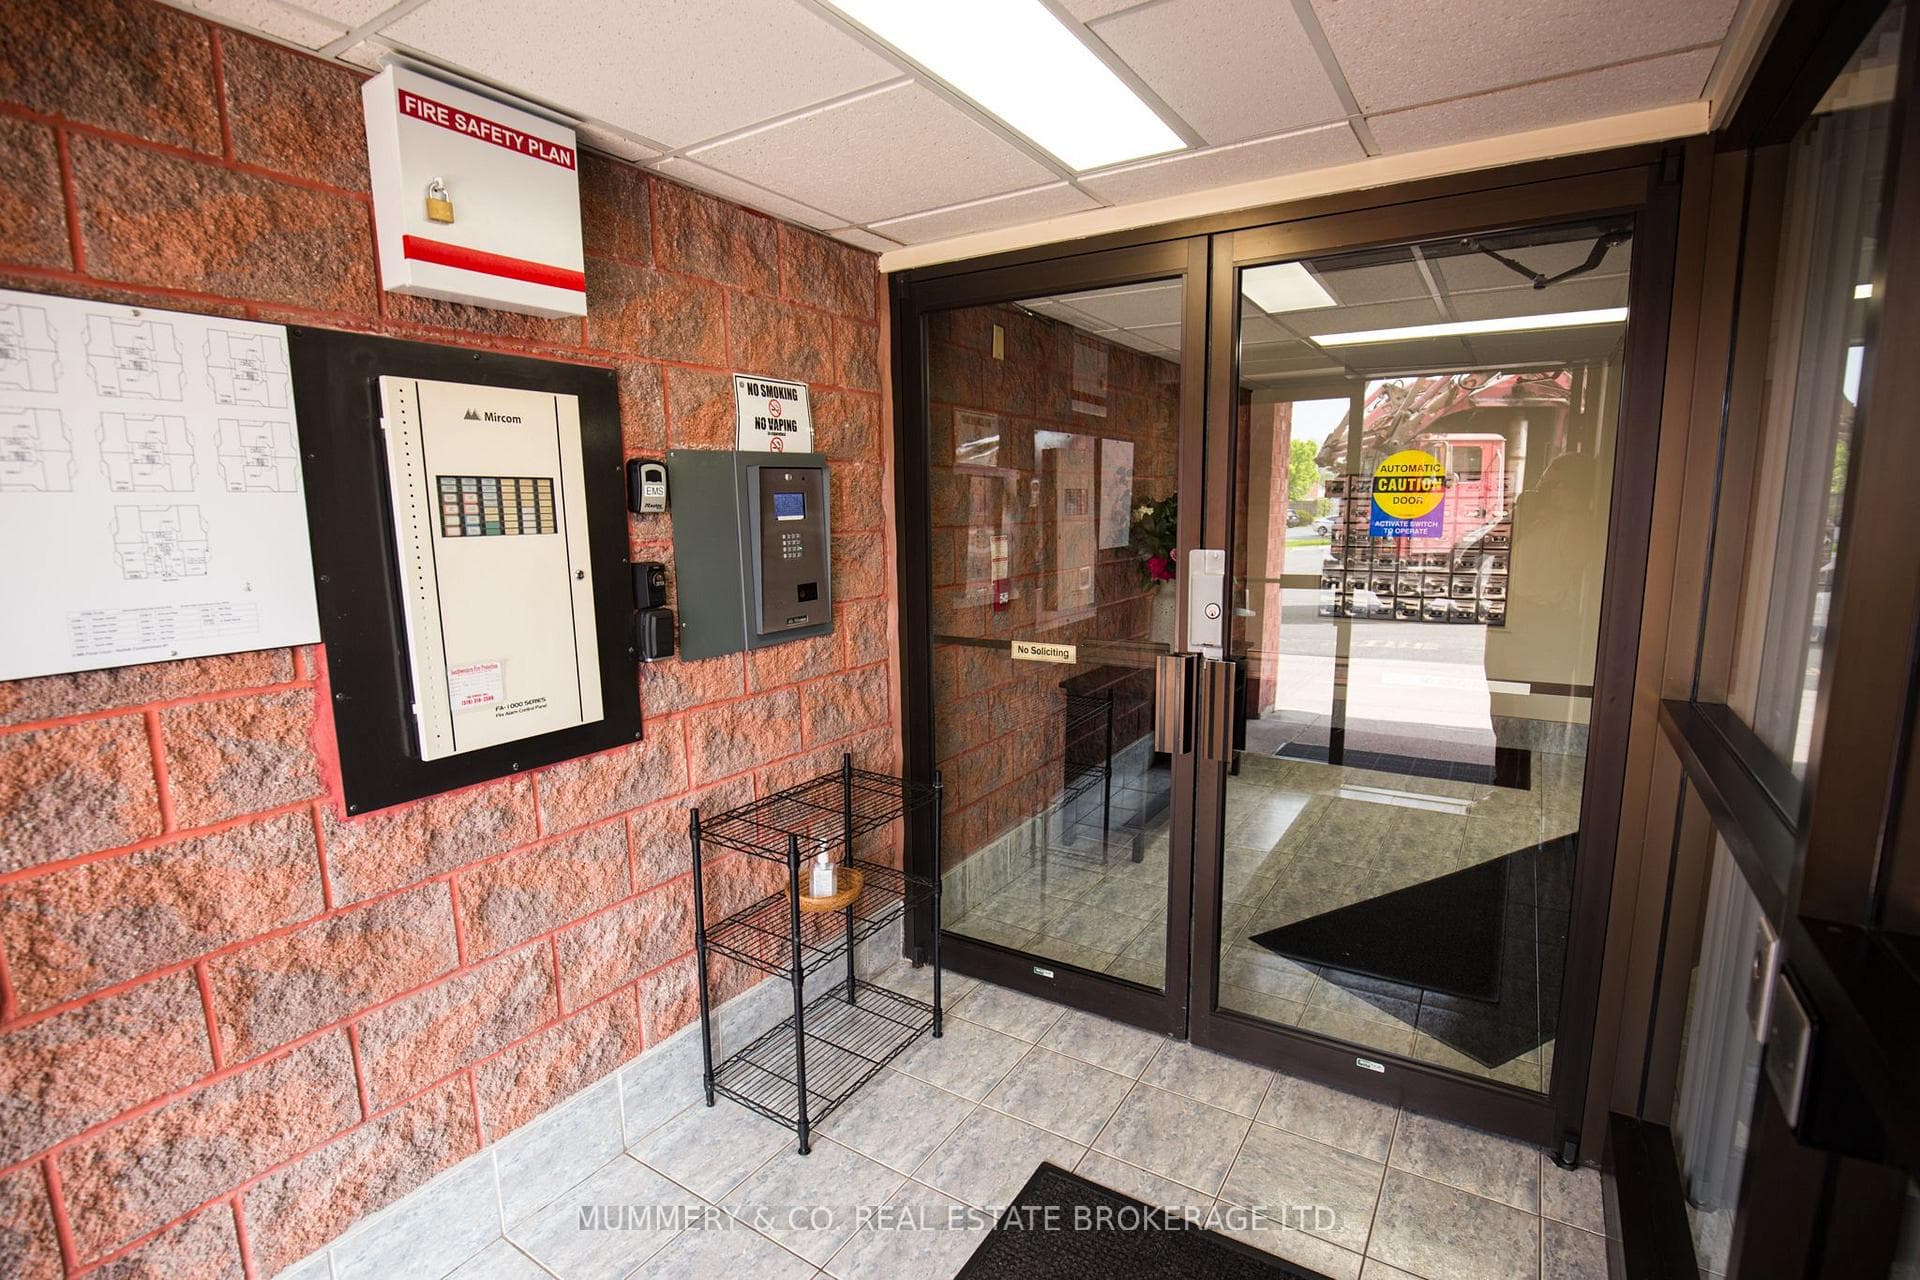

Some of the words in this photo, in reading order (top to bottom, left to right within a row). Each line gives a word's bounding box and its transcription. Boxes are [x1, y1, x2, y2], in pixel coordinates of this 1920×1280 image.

[405, 95, 449, 126] FIRE
[455, 113, 524, 151] SAFETY
[528, 138, 571, 167] PLAN
[747, 382, 759, 396] NO
[760, 384, 798, 401] SMOKING
[484, 412, 521, 424] Mircom
[754, 416, 766, 430] NO
[768, 418, 797, 432] VAPING
[1380, 464, 1441, 473] AUTOMATIC
[646, 486, 664, 496] EMS
[1378, 478, 1442, 492] CAUTION
[1393, 496, 1423, 505] DOOR
[1409, 520, 1439, 528] SWITCH
[1017, 645, 1029, 654] No
[1031, 646, 1069, 659] Soliciting
[495, 701, 523, 712] FA-1000
[524, 697, 547, 706] SERIES
